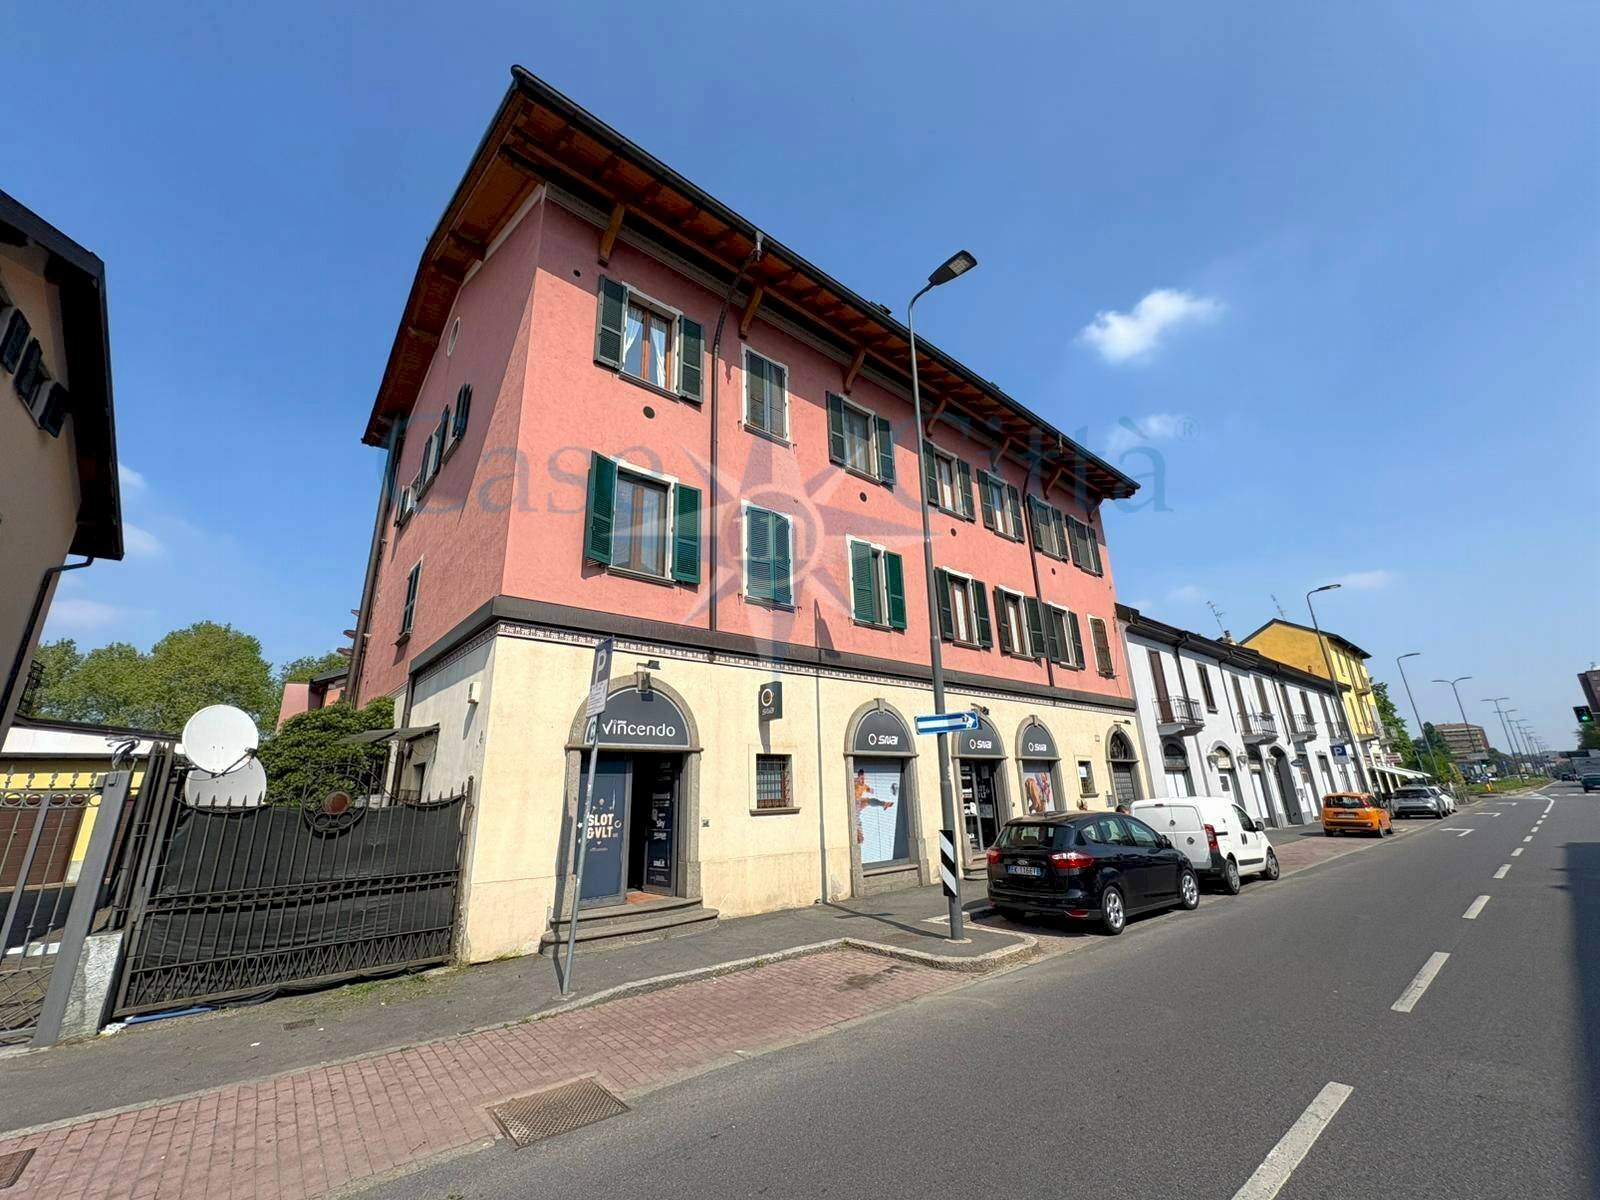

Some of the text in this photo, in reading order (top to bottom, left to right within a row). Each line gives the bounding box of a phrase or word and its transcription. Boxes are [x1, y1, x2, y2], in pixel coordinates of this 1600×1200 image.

[594, 649, 607, 687] P
[1333, 747, 1343, 757] P
[588, 813, 615, 827] SLOT
[586, 826, 614, 840] &VLT
